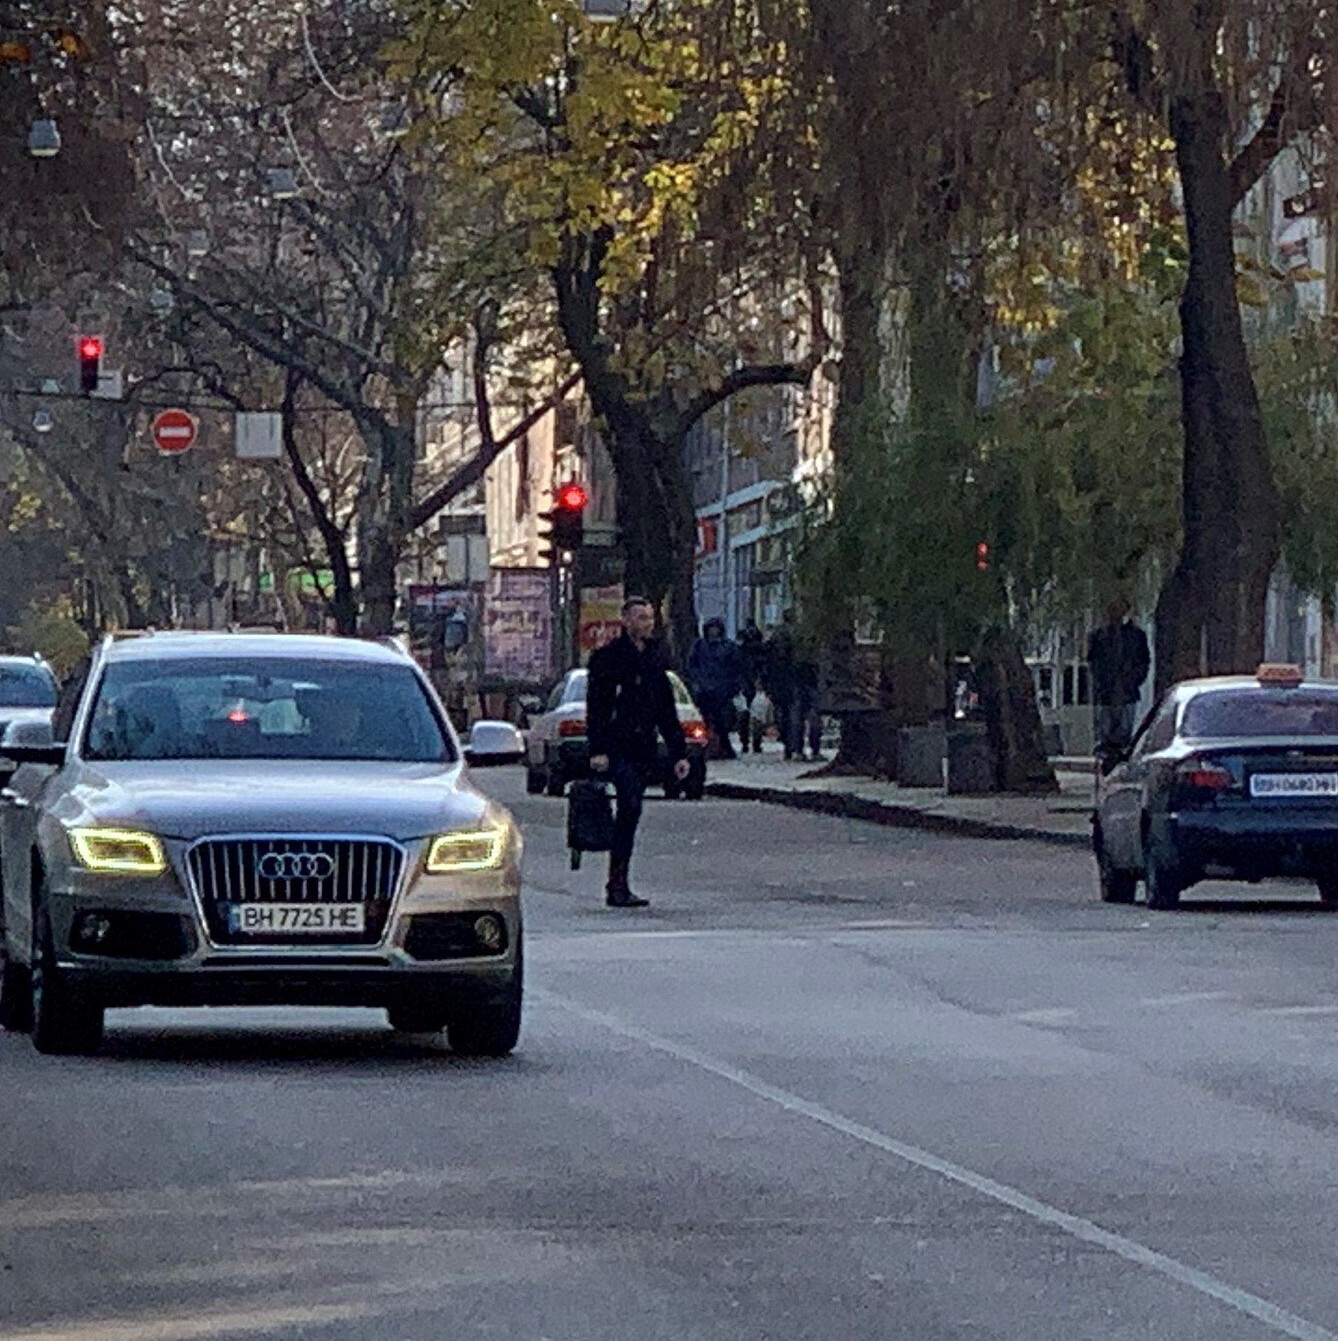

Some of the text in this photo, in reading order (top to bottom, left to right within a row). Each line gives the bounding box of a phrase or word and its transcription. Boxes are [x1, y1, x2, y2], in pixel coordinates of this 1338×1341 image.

[244, 907, 357, 928] BH 7725 HE
